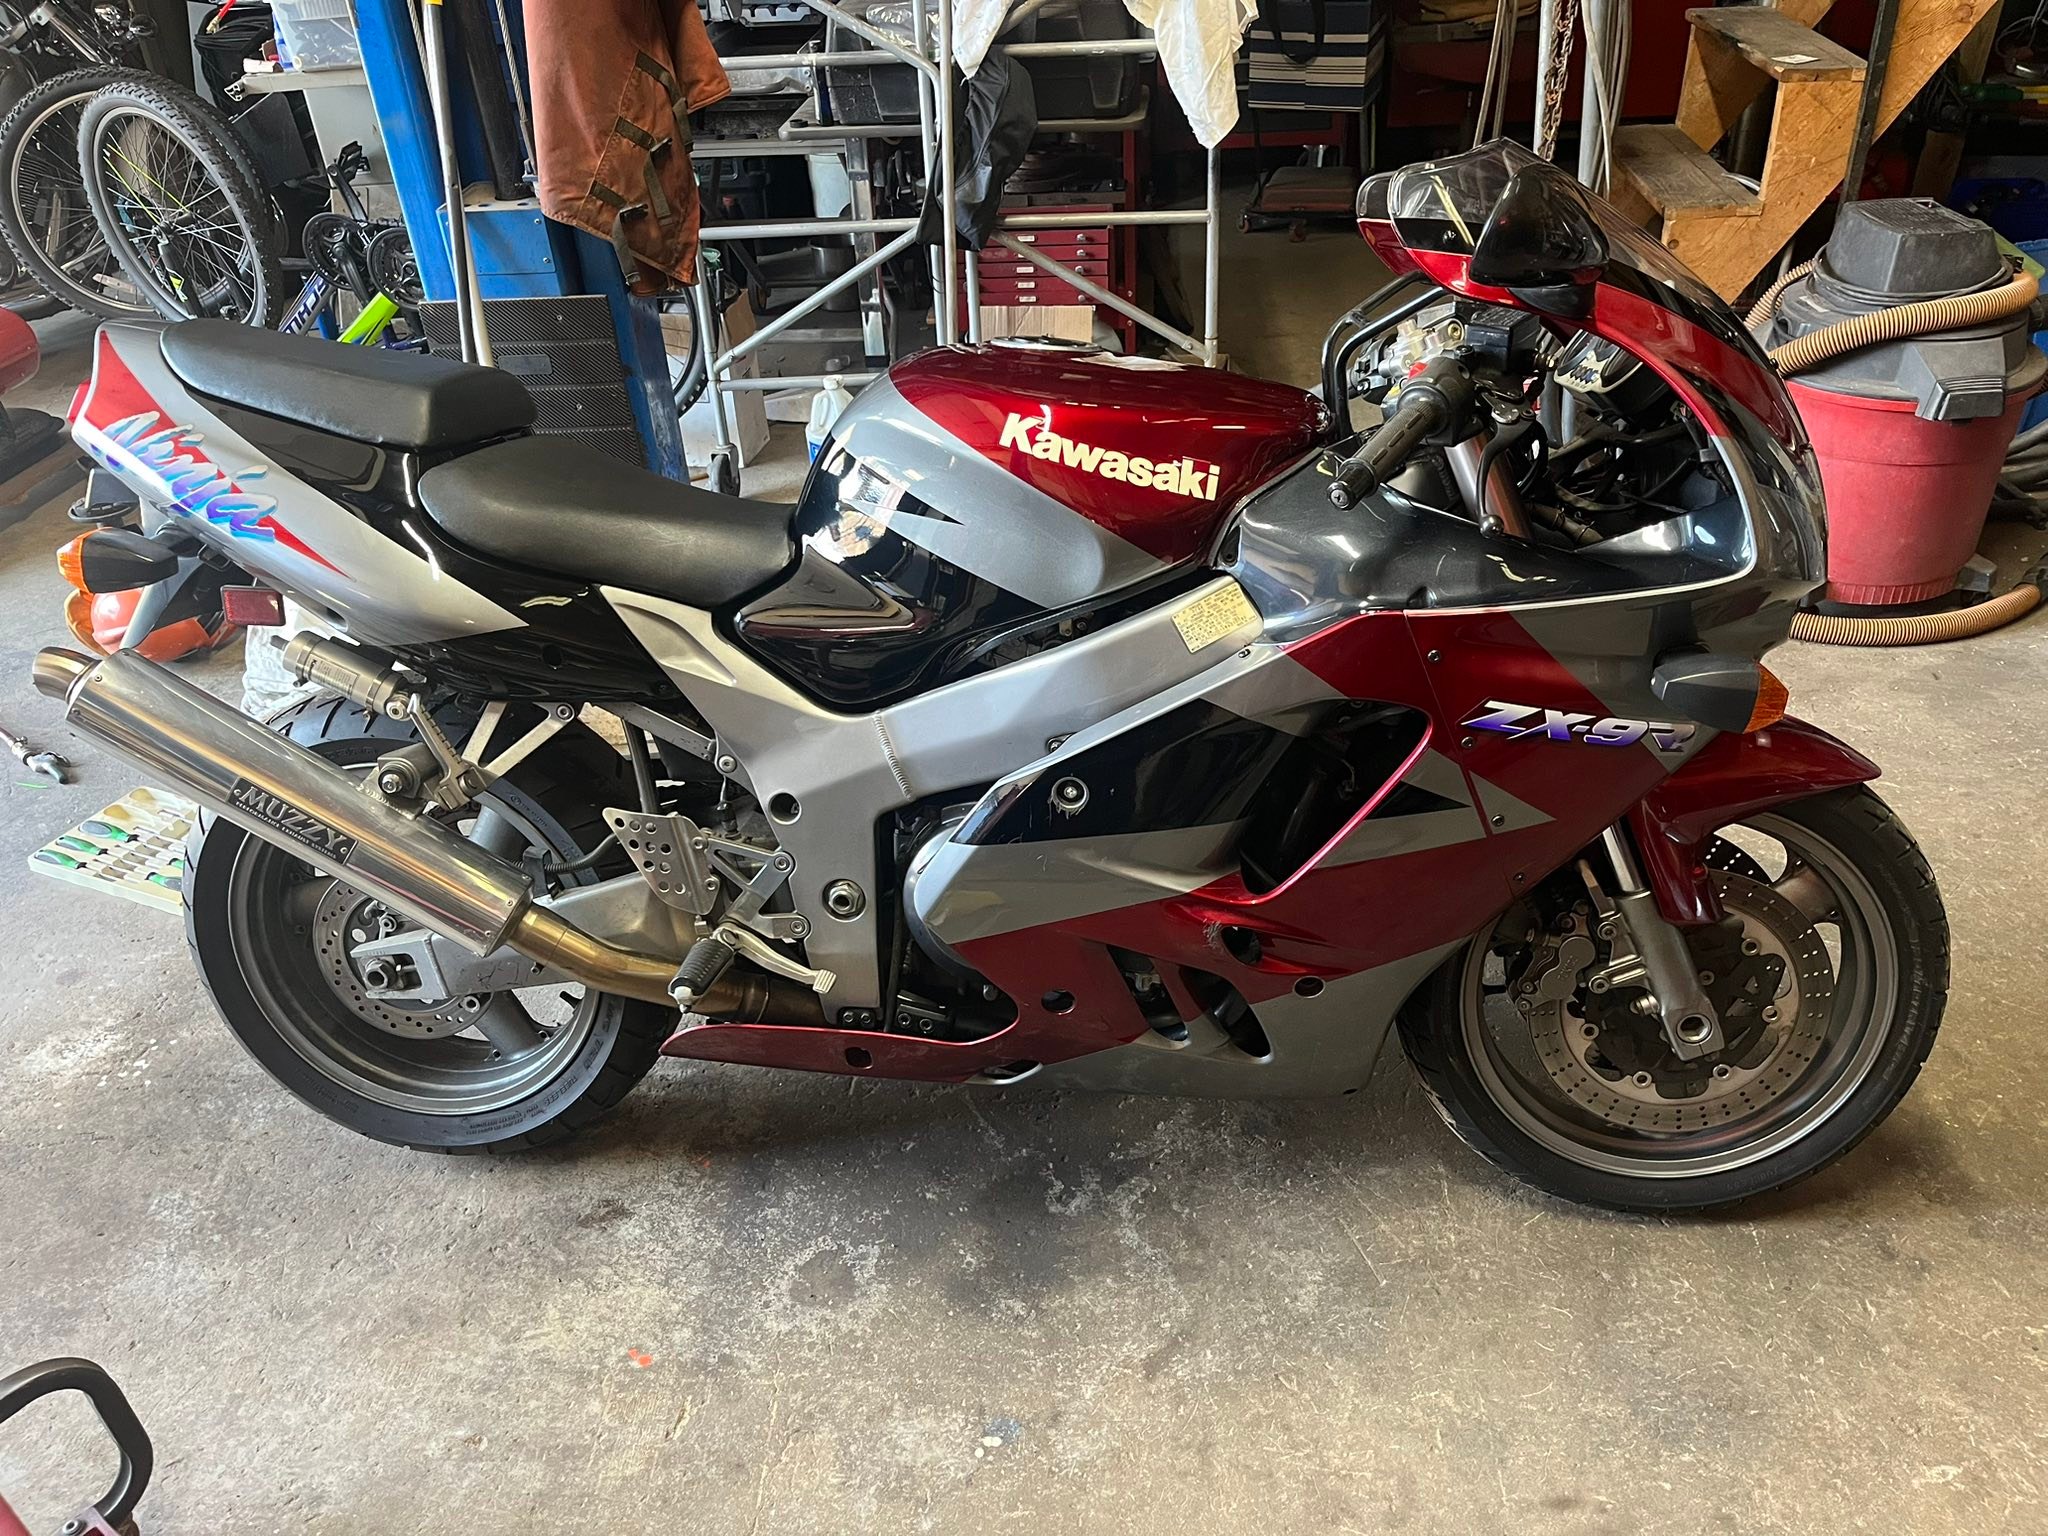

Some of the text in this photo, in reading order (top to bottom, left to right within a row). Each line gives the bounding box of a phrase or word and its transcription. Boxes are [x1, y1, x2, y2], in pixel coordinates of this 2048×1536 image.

[91, 410, 277, 543] Ninja
[998, 412, 1221, 501] Kawasaki
[1460, 699, 1696, 753] ZX-9R
[239, 785, 347, 851] MUZZY
